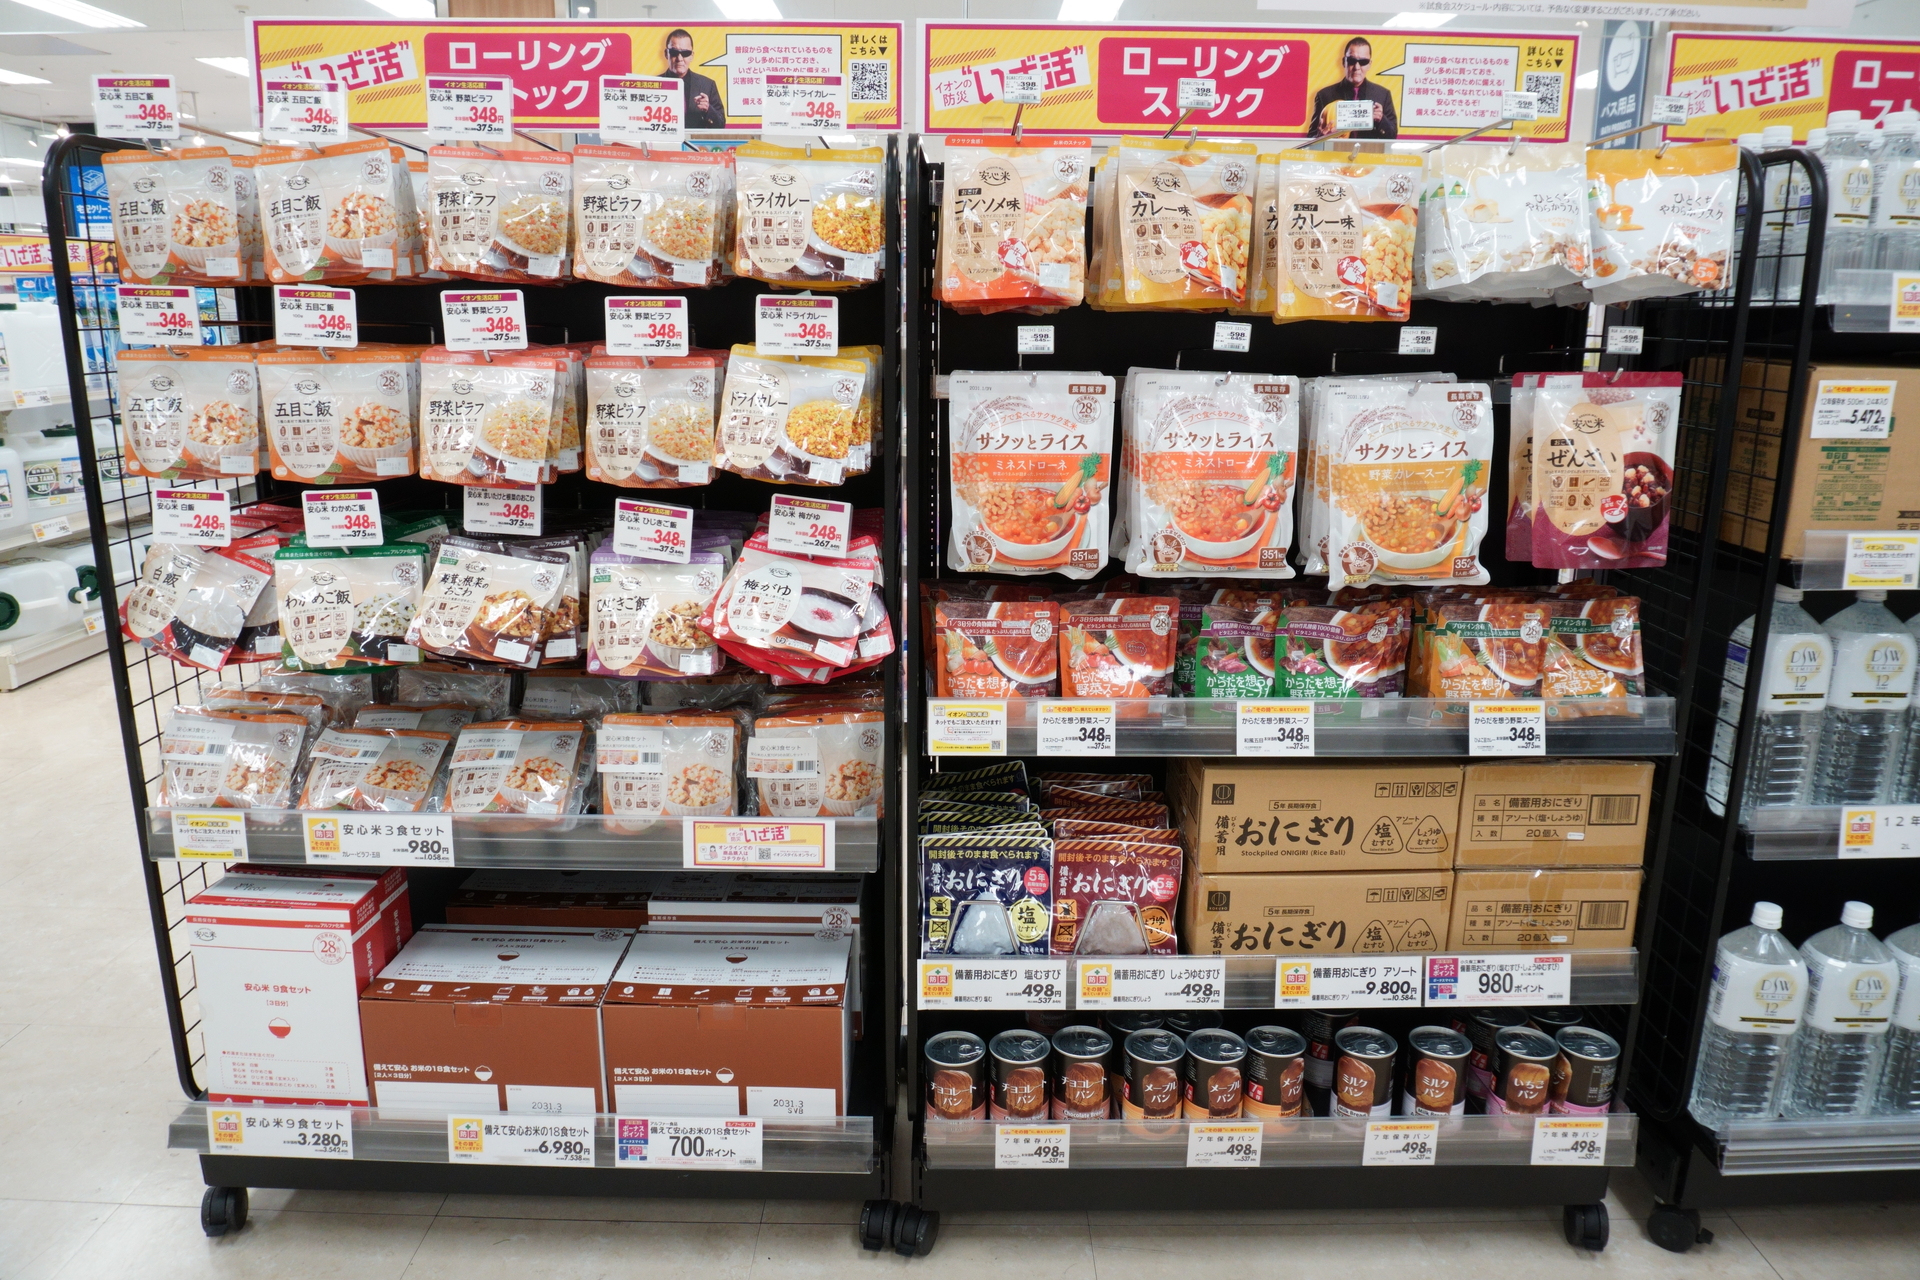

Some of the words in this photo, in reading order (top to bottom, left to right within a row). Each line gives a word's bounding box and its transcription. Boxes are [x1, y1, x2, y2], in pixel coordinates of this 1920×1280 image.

[851, 35, 887, 44] 詳しくは
[449, 37, 612, 71] ローリング
[735, 46, 832, 54] 普段から食べなれているものを
[851, 47, 877, 55] こちら
[1528, 46, 1564, 56] 詳しくは
[747, 56, 819, 64] 少し多めに買っておき、
[1123, 45, 1290, 79] ローリング
[1413, 56, 1509, 65] 普段から食べなれているものを
[1526, 59, 1551, 68] こちら
[1424, 67, 1495, 76] 少し多めに買っておき、
[935, 80, 972, 92] イオンの
[1414, 77, 1505, 86] いざという時のために備える!
[100, 92, 122, 101] 安心米
[125, 92, 154, 100] 五目ご飯
[430, 94, 452, 102] 安心米
[456, 94, 492, 103] 野菜ピラフ
[767, 89, 790, 98] 安心米
[793, 90, 836, 98] ドライカレー
[943, 92, 969, 105] 防災
[1142, 89, 1264, 119] スック
[1436, 98, 1480, 107] 安心できるぞ!
[1601, 94, 1636, 118] バス用品
[119, 198, 166, 217] 五目ご飯
[583, 196, 642, 213] 野菜ピラフ
[1132, 198, 1192, 217] カレー味
[1291, 212, 1356, 230] カレー味
[280, 302, 302, 310] 安心米
[306, 303, 334, 311] 五目ご飯
[447, 306, 469, 315] 安心米
[472, 306, 508, 314] 野菜ピラフ
[1072, 385, 1102, 394] 長期保存
[274, 400, 333, 418] 五目ご飯
[429, 400, 484, 417] 野菜ピラフ
[988, 412, 1078, 431] スープで食べるサクサク玄米
[976, 432, 1087, 451] サクッとライス
[1164, 431, 1274, 450] サクッとライス
[1356, 440, 1469, 461] サクッとライス
[1547, 449, 1617, 469] ぜんざい
[996, 460, 1068, 470] ミネストローネ
[1369, 466, 1456, 481] 野菜カレースープ
[468, 491, 481, 499] 安心米
[483, 492, 535, 502] まいたけと根菜のおこわ
[157, 502, 178, 510] 安心米
[307, 505, 328, 514] 安心米
[774, 509, 795, 518] 安心米
[799, 512, 820, 521] 梅がゆ
[619, 514, 640, 524] 安心米
[642, 517, 677, 528] ひじきご飯
[152, 566, 182, 586] 白飯
[444, 586, 472, 597] おこわ
[742, 579, 791, 596] 梅がゆ
[1795, 676, 1807, 687] 12
[1042, 716, 1111, 725] からだを想う野菜スープ
[1242, 716, 1309, 725] からだを想う野菜スープ
[1474, 716, 1541, 725] からだを想う野菜スープ
[1287, 802, 1319, 810] 長期保存食
[1508, 797, 1583, 809] 備蓄用おにぎり
[1215, 815, 1229, 856] 備蓄用
[1235, 815, 1354, 847] おにぎり
[1526, 829, 1560, 839] 20個入
[929, 850, 1039, 860] 開封後そのまま食べられます
[1241, 849, 1278, 857] Stockpiled
[1280, 849, 1308, 857] ONIGIRI
[1310, 849, 1327, 857] (Rice
[1329, 849, 1346, 857] Ball)
[1059, 852, 1169, 867] 開封後そのまま食べられます
[946, 868, 1024, 892] おにぎり
[1018, 908, 1037, 926] 塩
[320, 940, 336, 953] 28
[955, 969, 1018, 980] 備蓄用おにぎり
[1024, 969, 1061, 980] 塩むすび
[1114, 969, 1165, 980] 備蓄用おにぎり
[1170, 968, 1220, 980] しょうゆむすび
[1313, 966, 1377, 979] 備蓄用おにぎり
[1384, 966, 1417, 977] アソート
[244, 983, 270, 992] 安心米
[273, 985, 311, 994] 9食セット
[1478, 972, 1513, 994] 980
[1514, 984, 1544, 993] ポイント
[373, 1064, 409, 1072] 備えて安心
[411, 1064, 470, 1073] お米の18食セット
[1342, 1073, 1368, 1088] ミルク
[1514, 1078, 1545, 1088] いちご
[931, 1081, 977, 1094] チョコレート
[1145, 1081, 1177, 1092] メープル
[773, 1099, 804, 1108] 2031.3
[943, 1097, 963, 1106] パン
[484, 1125, 589, 1138] 備えて安心お米の18食セット
[650, 1127, 751, 1136] 備えて安心お米の18食セット
[669, 1136, 705, 1157] 700
[705, 1149, 736, 1158] ポイント
